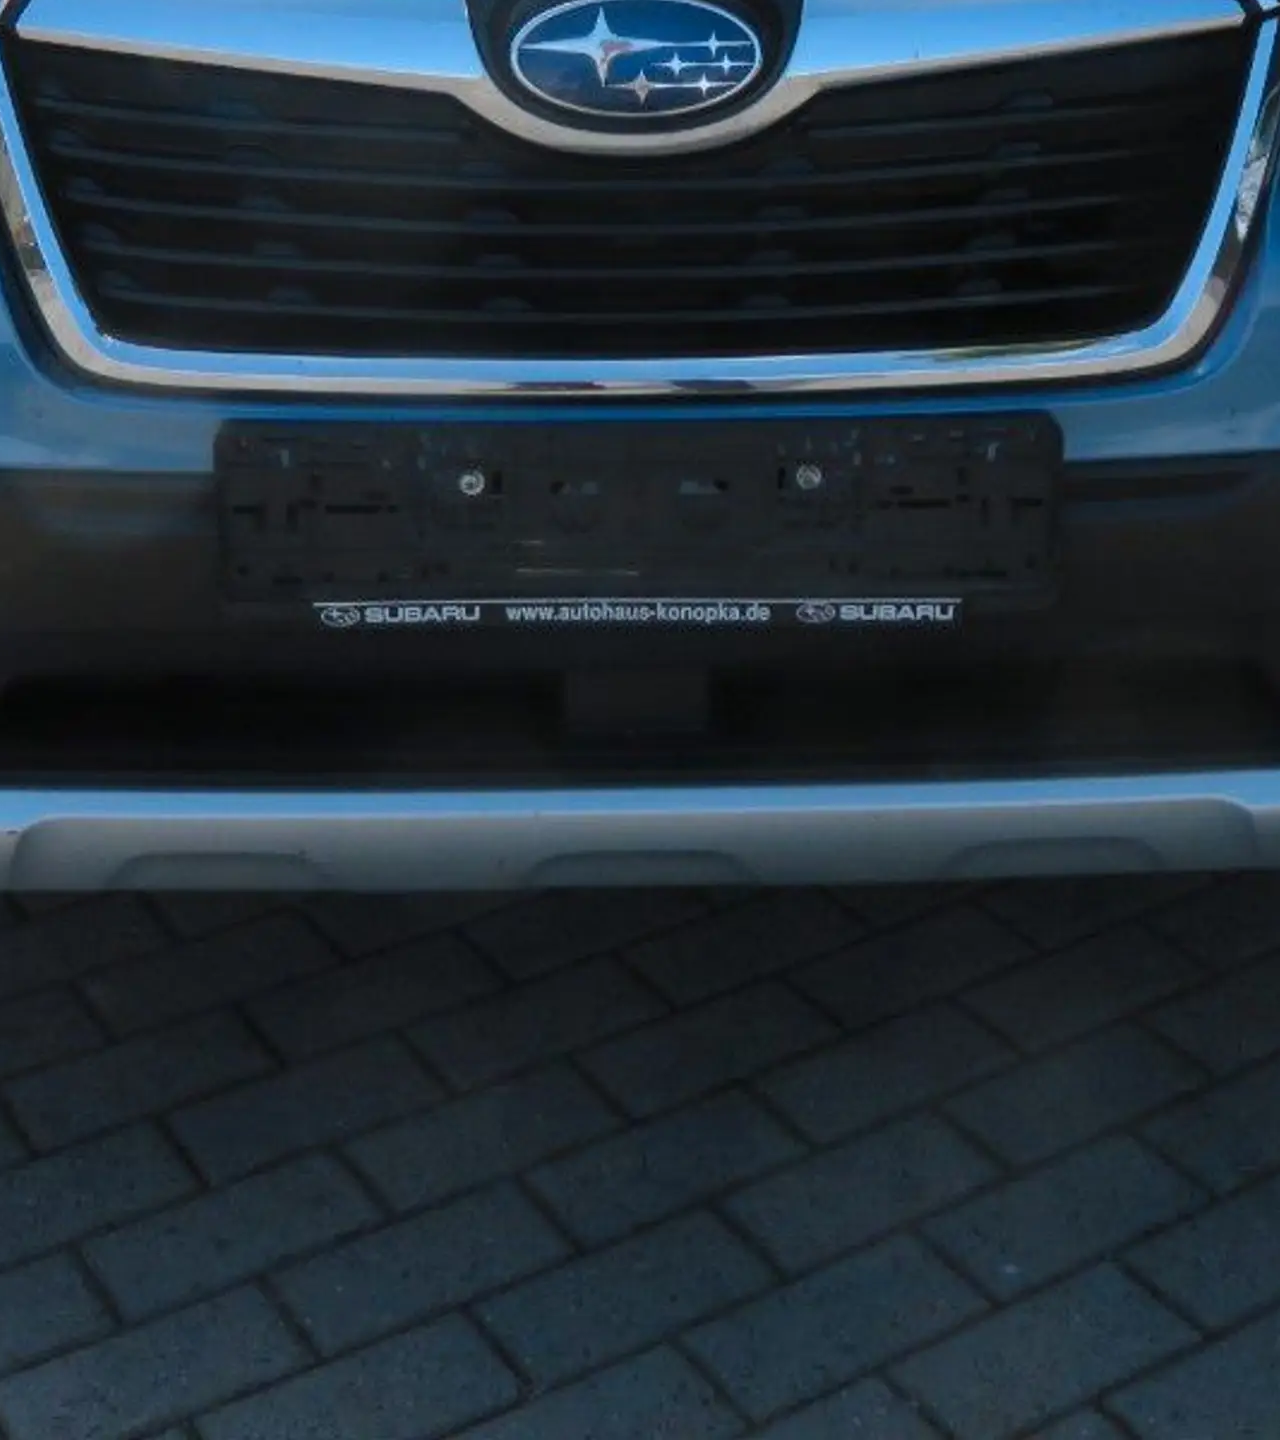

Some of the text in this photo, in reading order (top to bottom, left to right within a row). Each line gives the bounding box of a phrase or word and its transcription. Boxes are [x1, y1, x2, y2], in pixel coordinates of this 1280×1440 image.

[364, 602, 956, 623] SUBARU www.autohaus-konopka.de SUBARU
